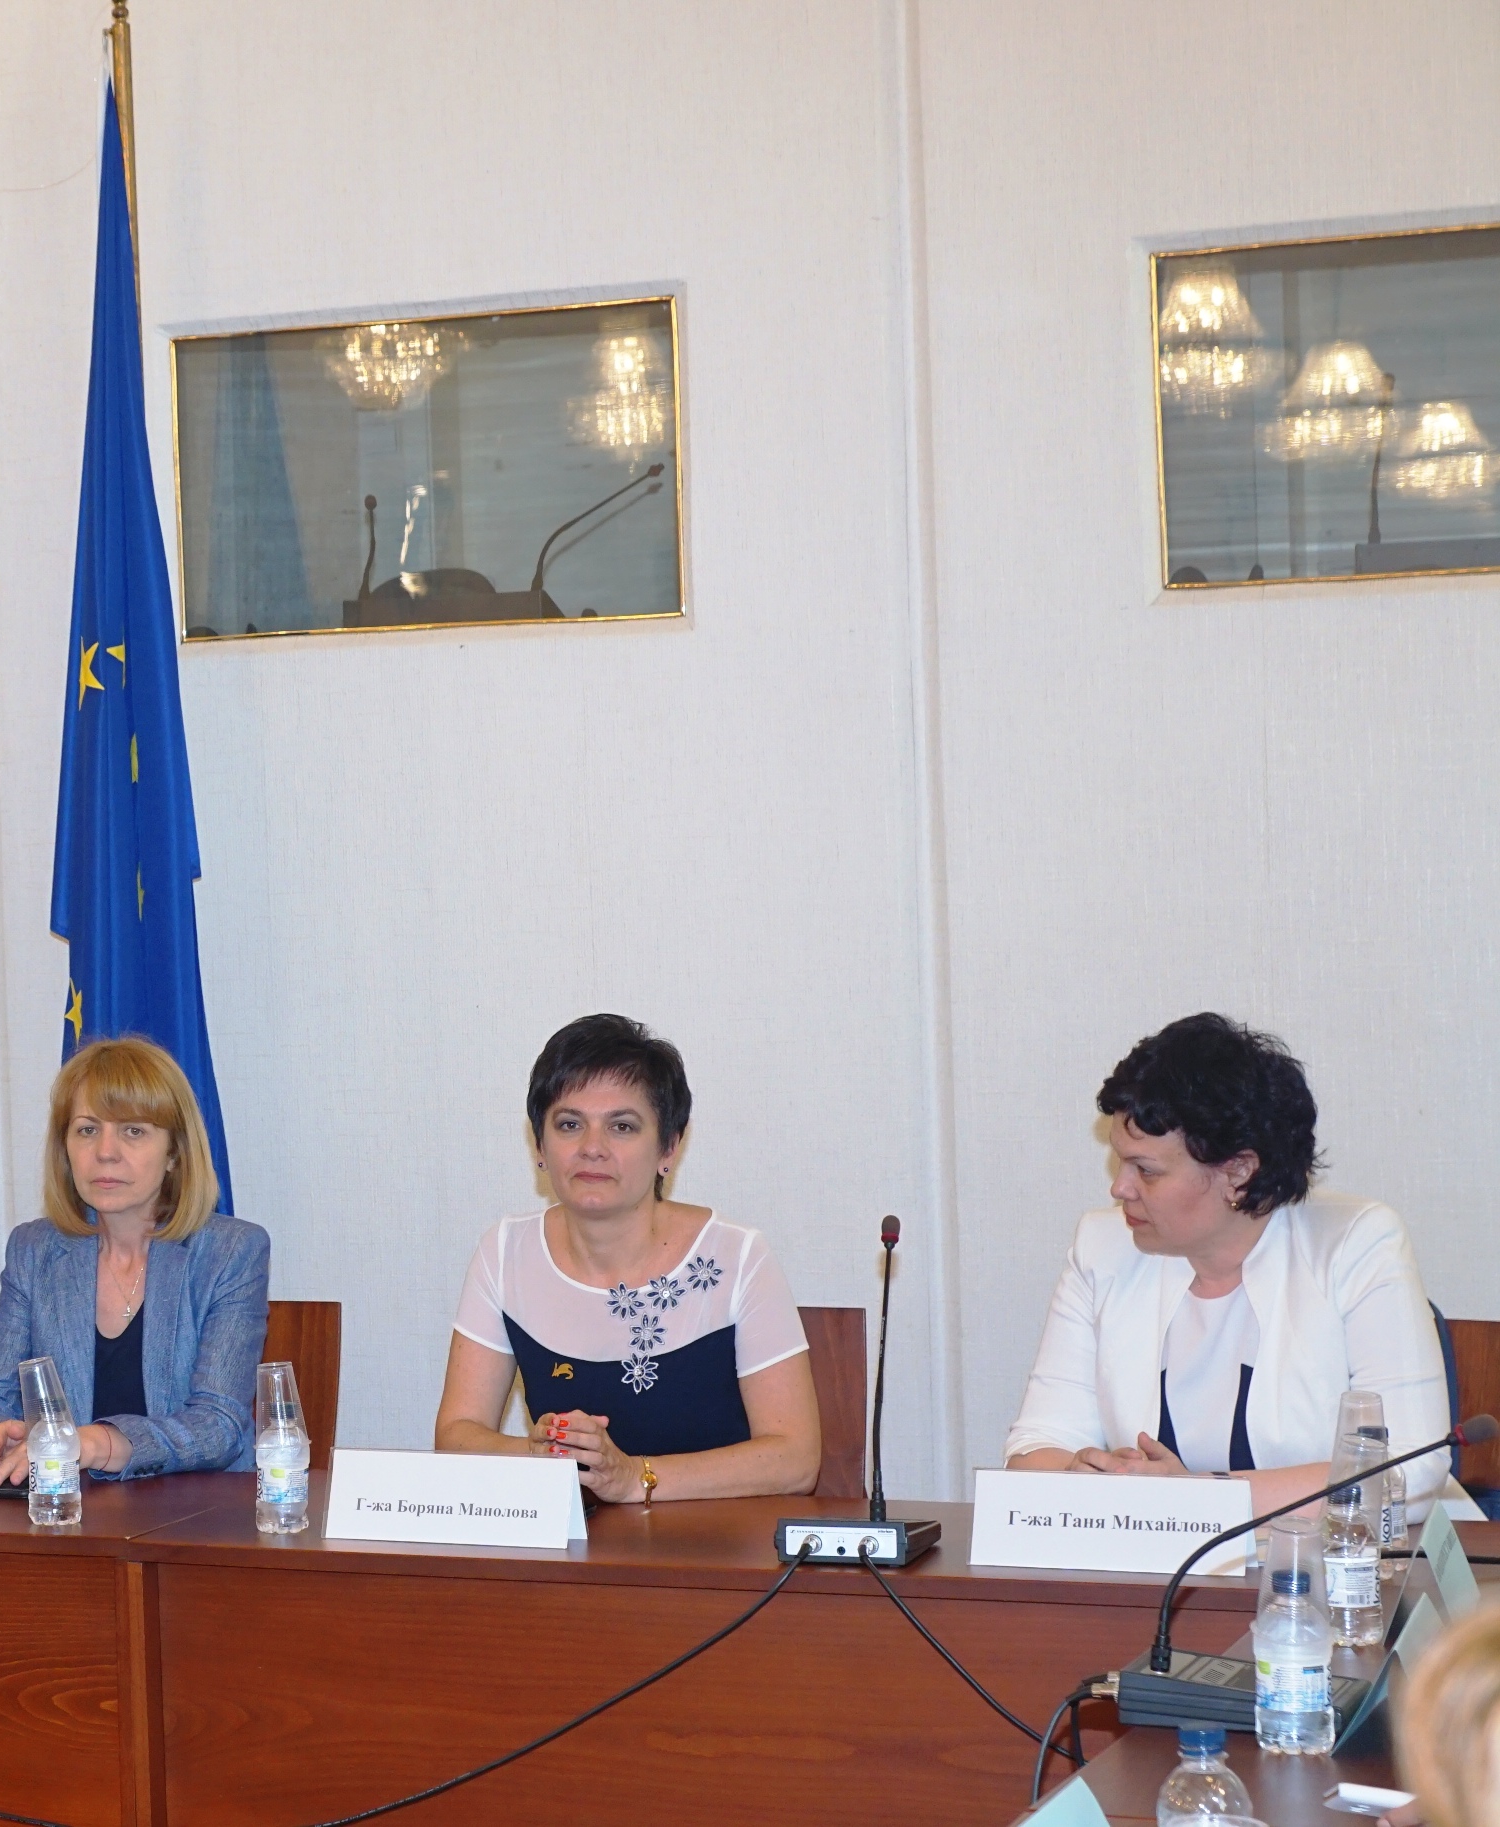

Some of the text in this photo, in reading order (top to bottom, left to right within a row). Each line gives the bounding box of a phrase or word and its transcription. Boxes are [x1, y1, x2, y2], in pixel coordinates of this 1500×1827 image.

[355, 1497, 538, 1519] Г-жа Боряна Манолова
[1008, 1510, 1223, 1534] Г-жа Таня Михайлова
